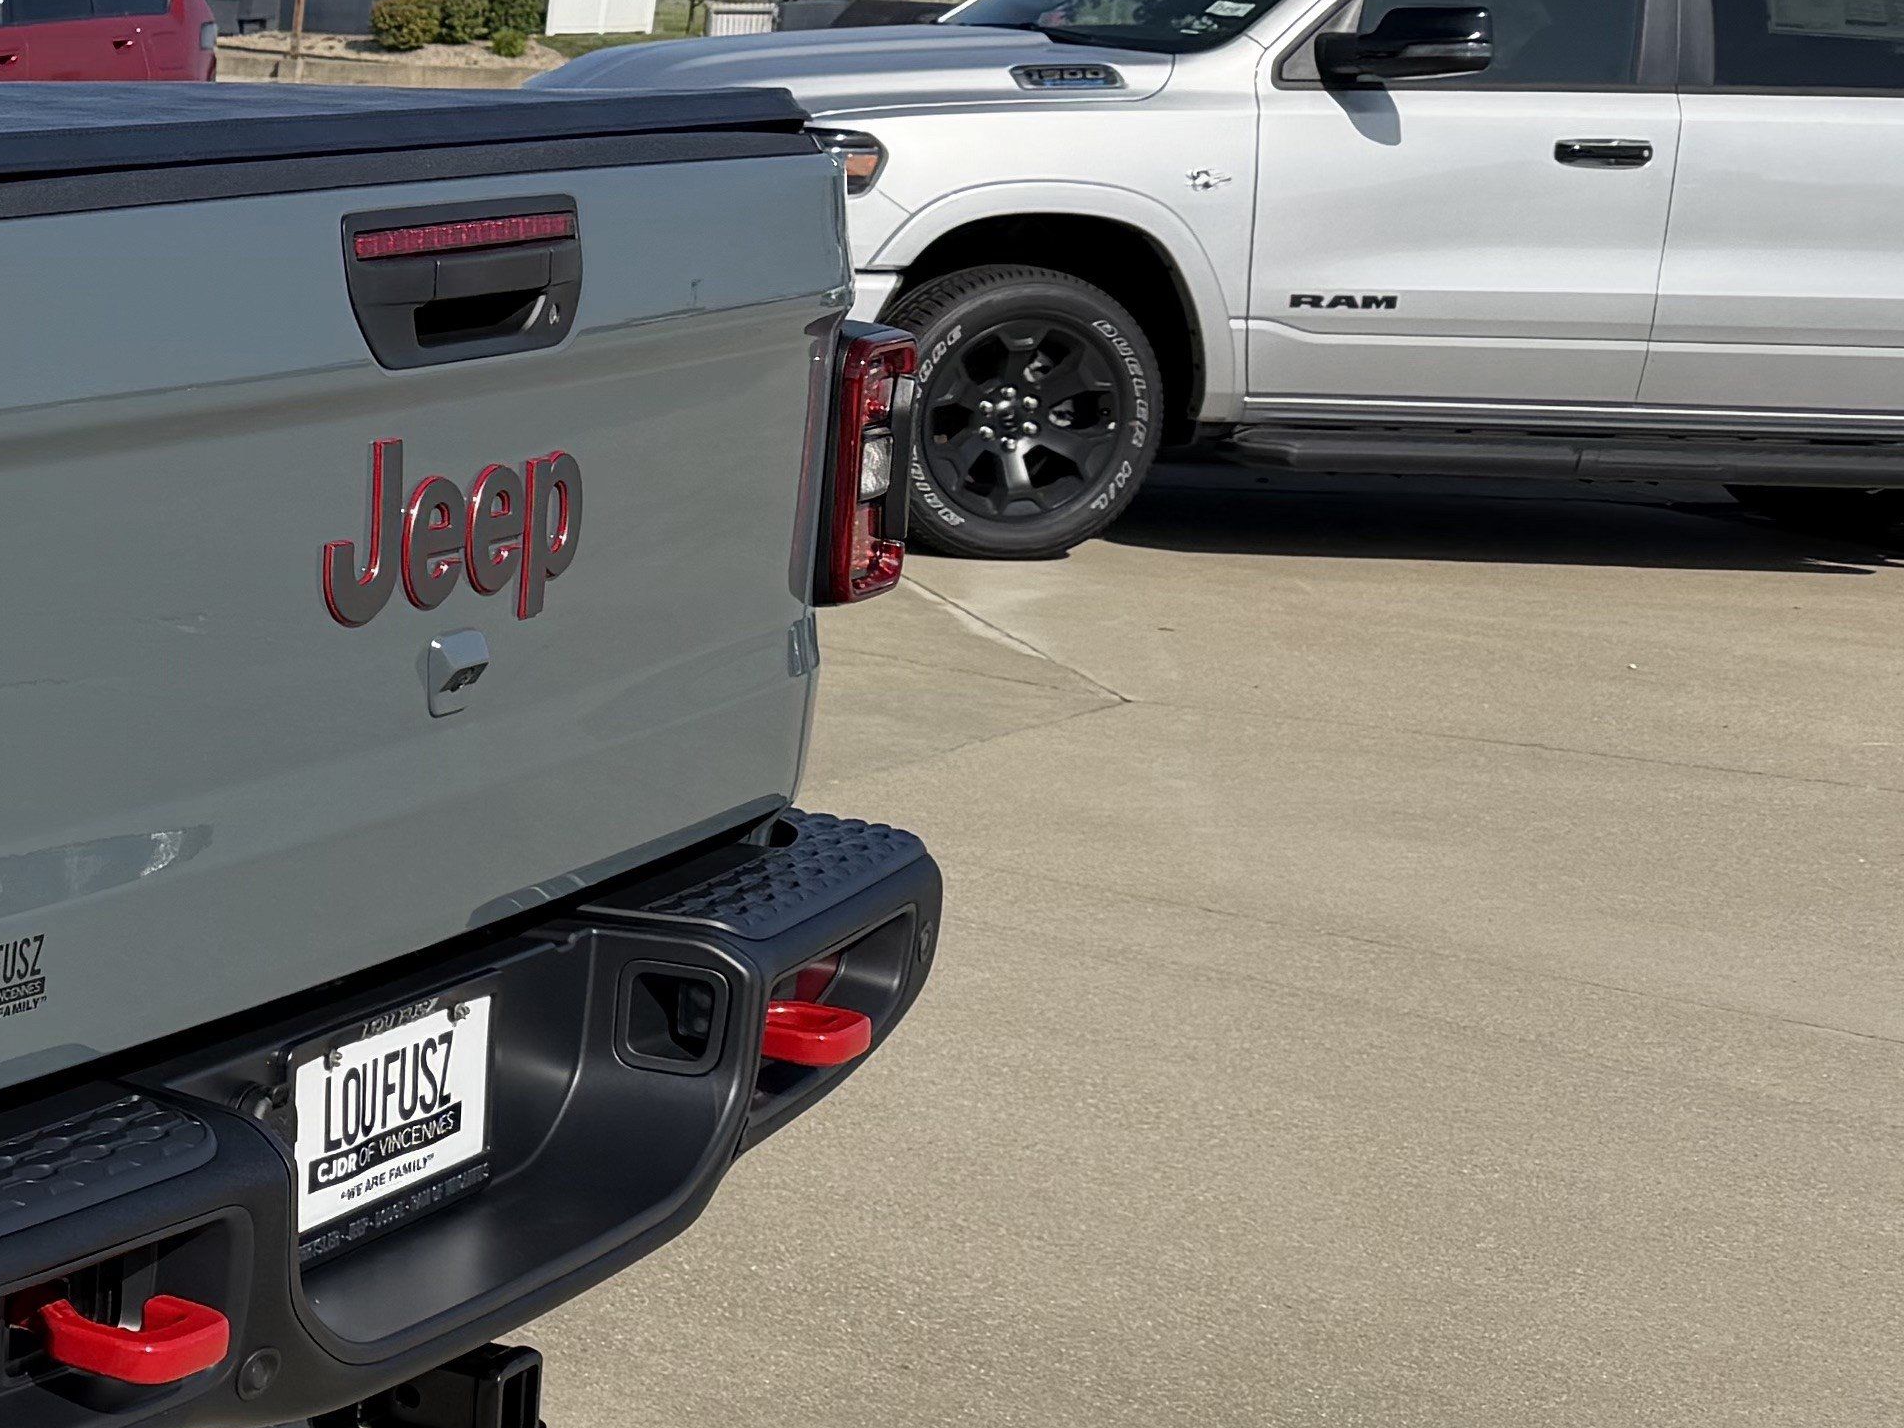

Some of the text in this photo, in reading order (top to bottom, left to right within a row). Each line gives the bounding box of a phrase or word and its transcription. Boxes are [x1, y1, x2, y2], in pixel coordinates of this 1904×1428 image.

[1289, 294, 1398, 310] RAM
[323, 438, 583, 628] Jeep
[317, 1110, 454, 1183] CJDR OF VINCENNES
[364, 1173, 387, 1193] ARE
